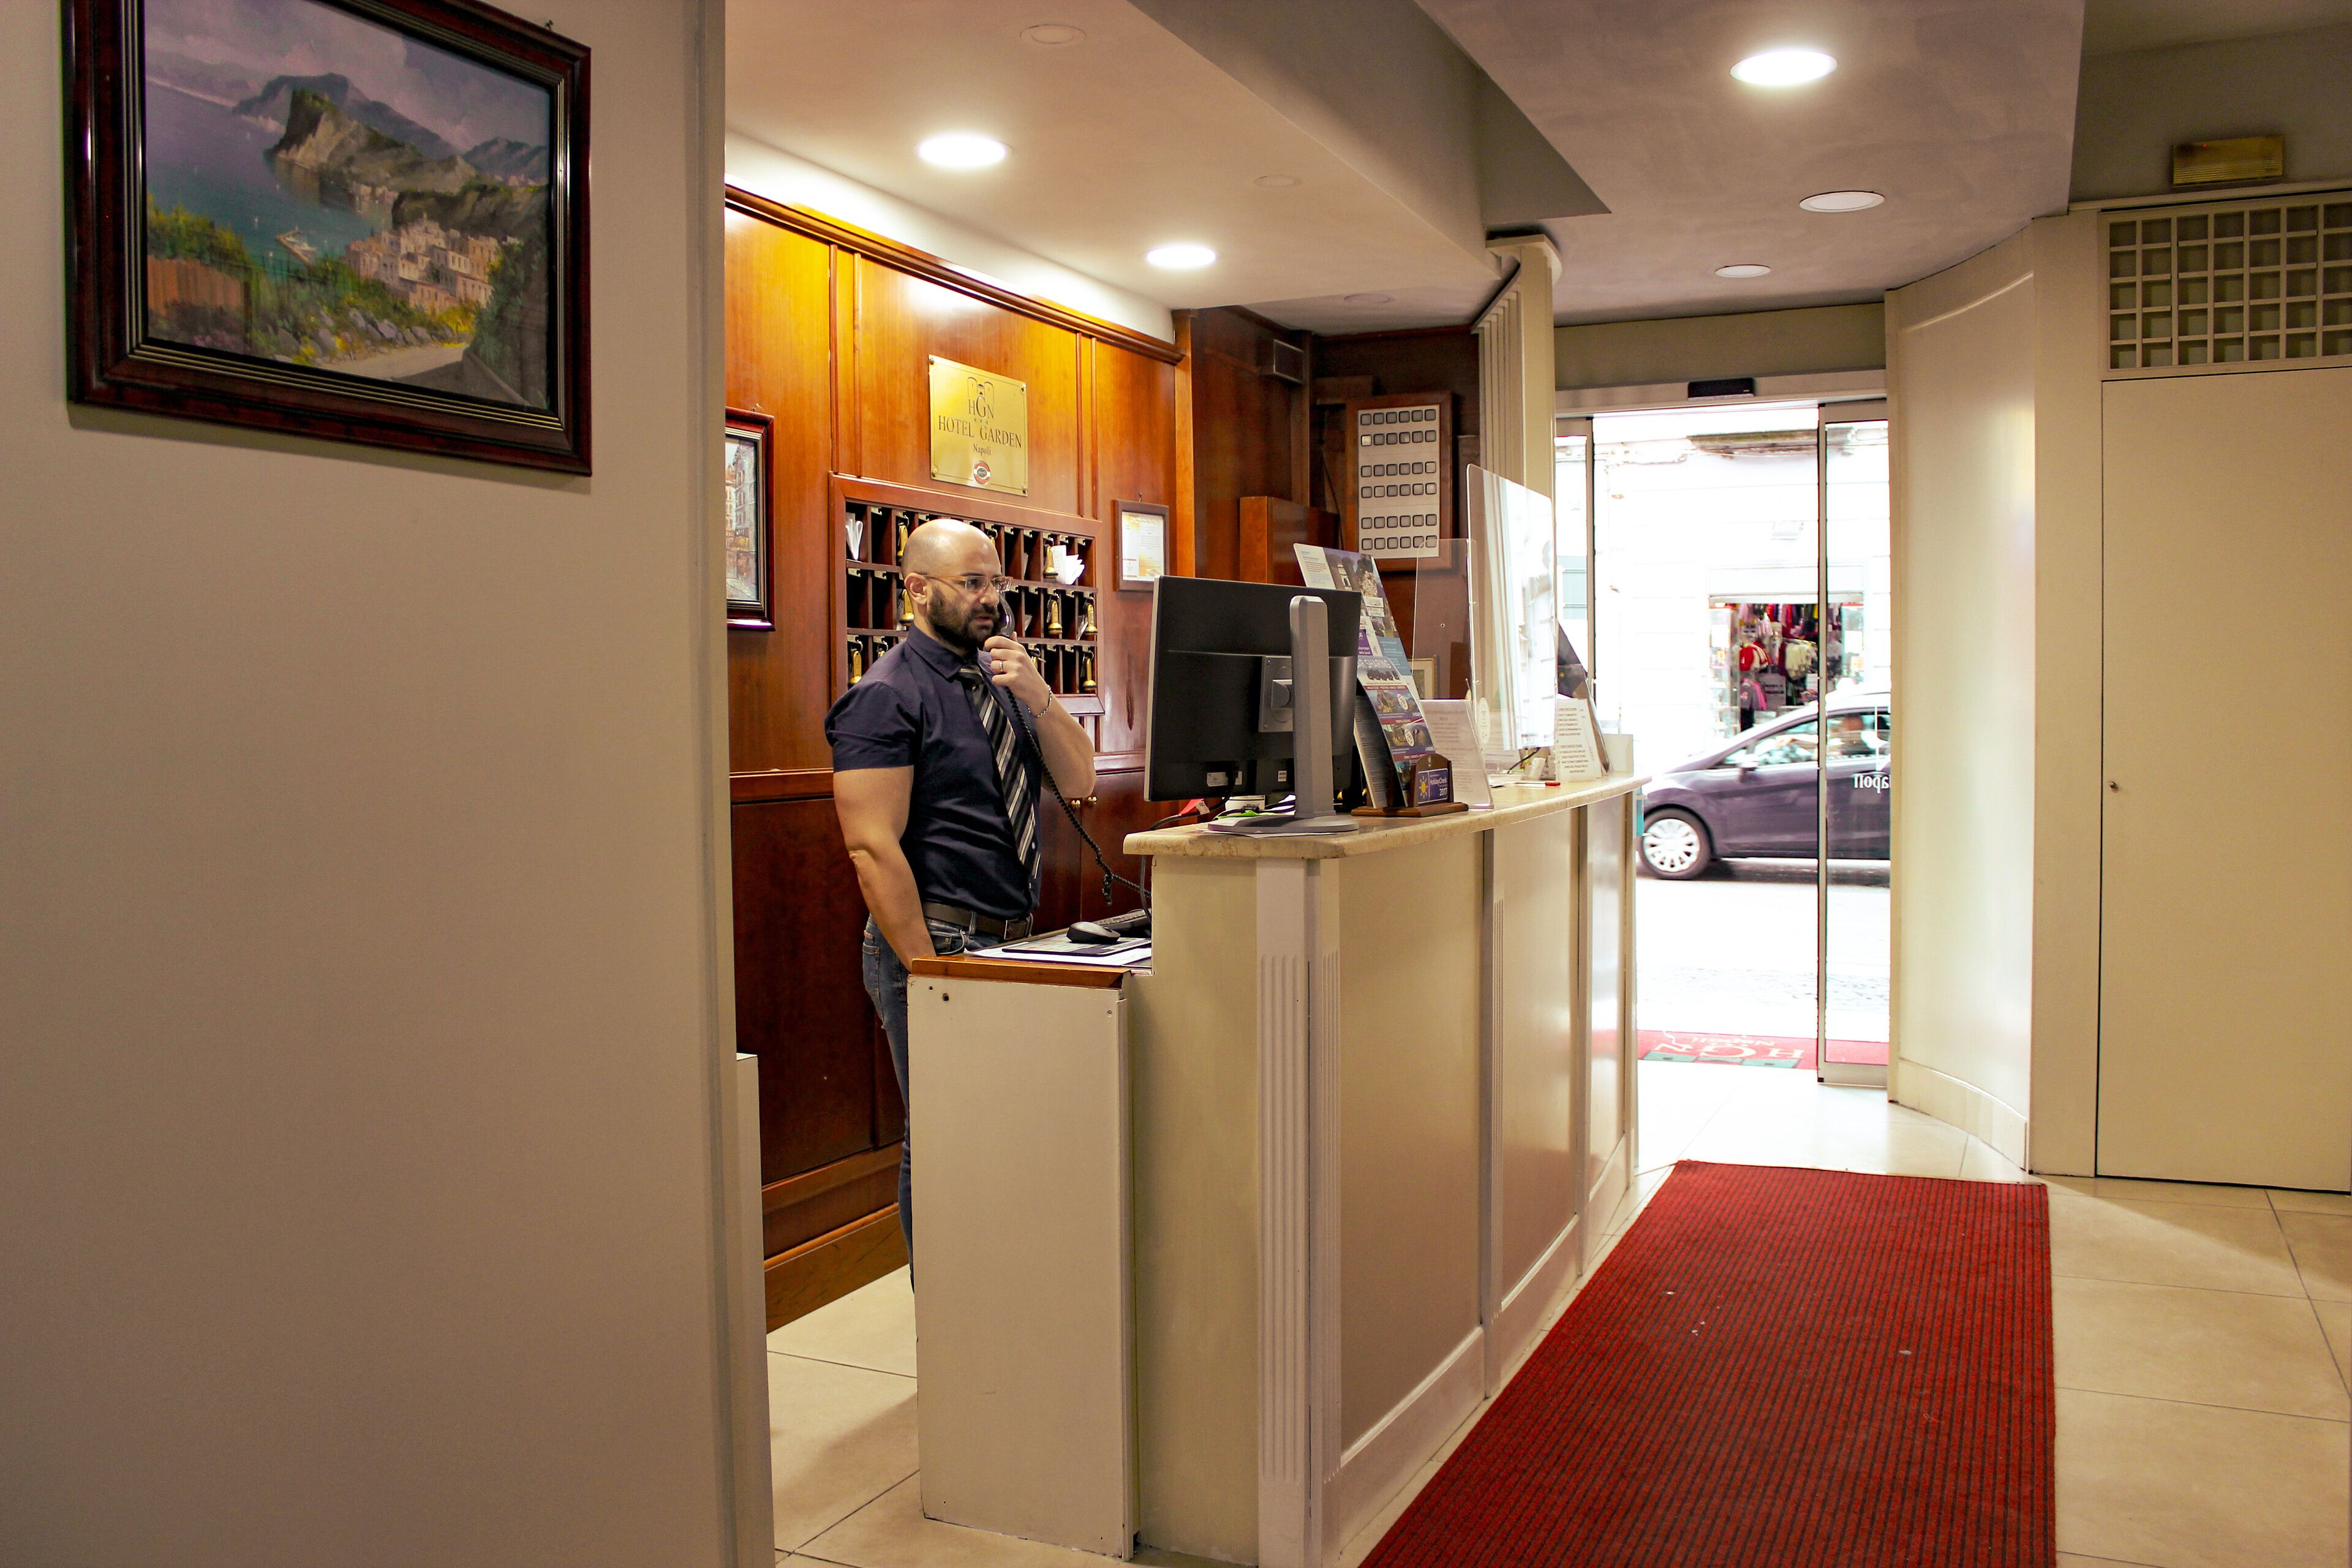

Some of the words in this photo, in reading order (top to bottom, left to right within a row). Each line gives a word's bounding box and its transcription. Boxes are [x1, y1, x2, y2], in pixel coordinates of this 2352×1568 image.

[968, 396, 994, 420] HGN
[938, 415, 974, 437] HOTEL
[980, 425, 1022, 448] GARDEN
[973, 443, 991, 456] Napoli
